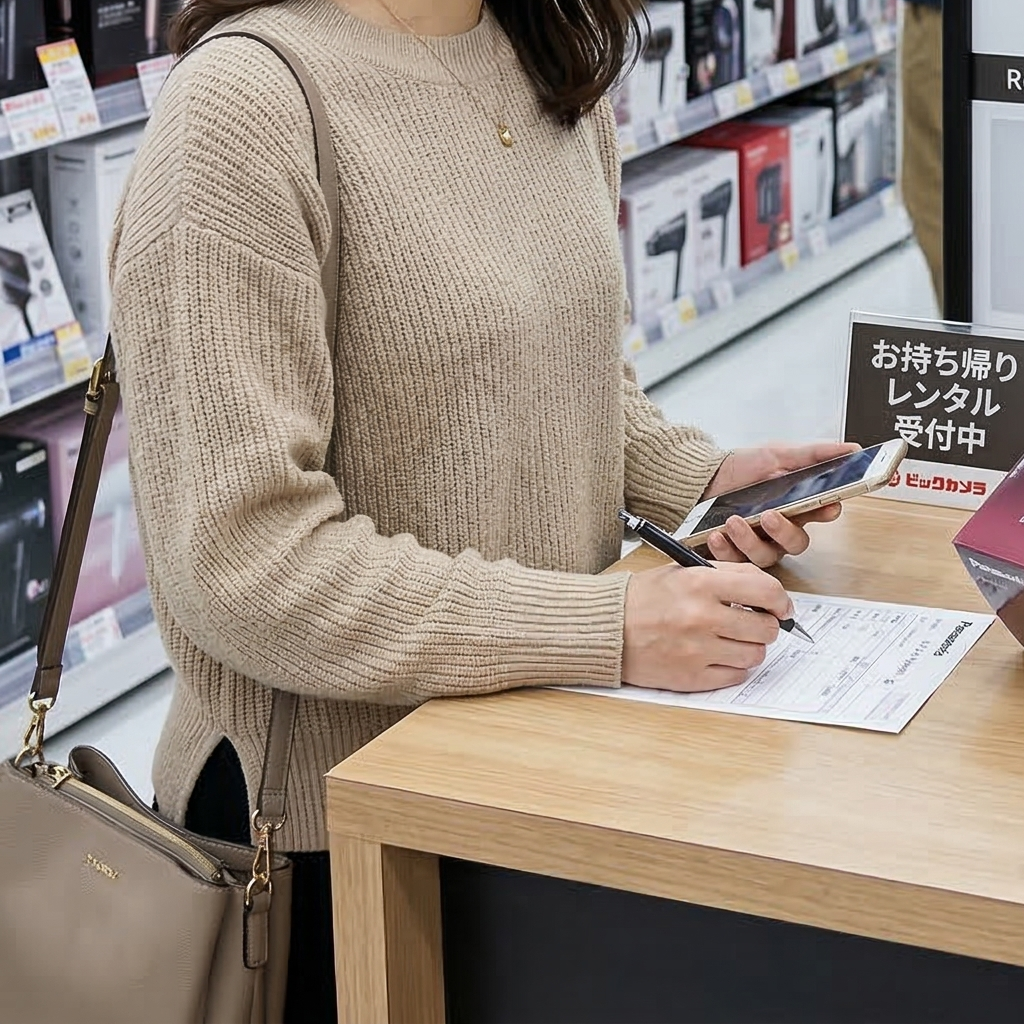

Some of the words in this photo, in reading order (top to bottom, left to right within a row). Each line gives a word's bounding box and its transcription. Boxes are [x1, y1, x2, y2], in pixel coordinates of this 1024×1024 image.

[870, 339, 1018, 383] お持ち帰り
[888, 378, 1001, 417] レンタル
[894, 414, 987, 455] 受付中
